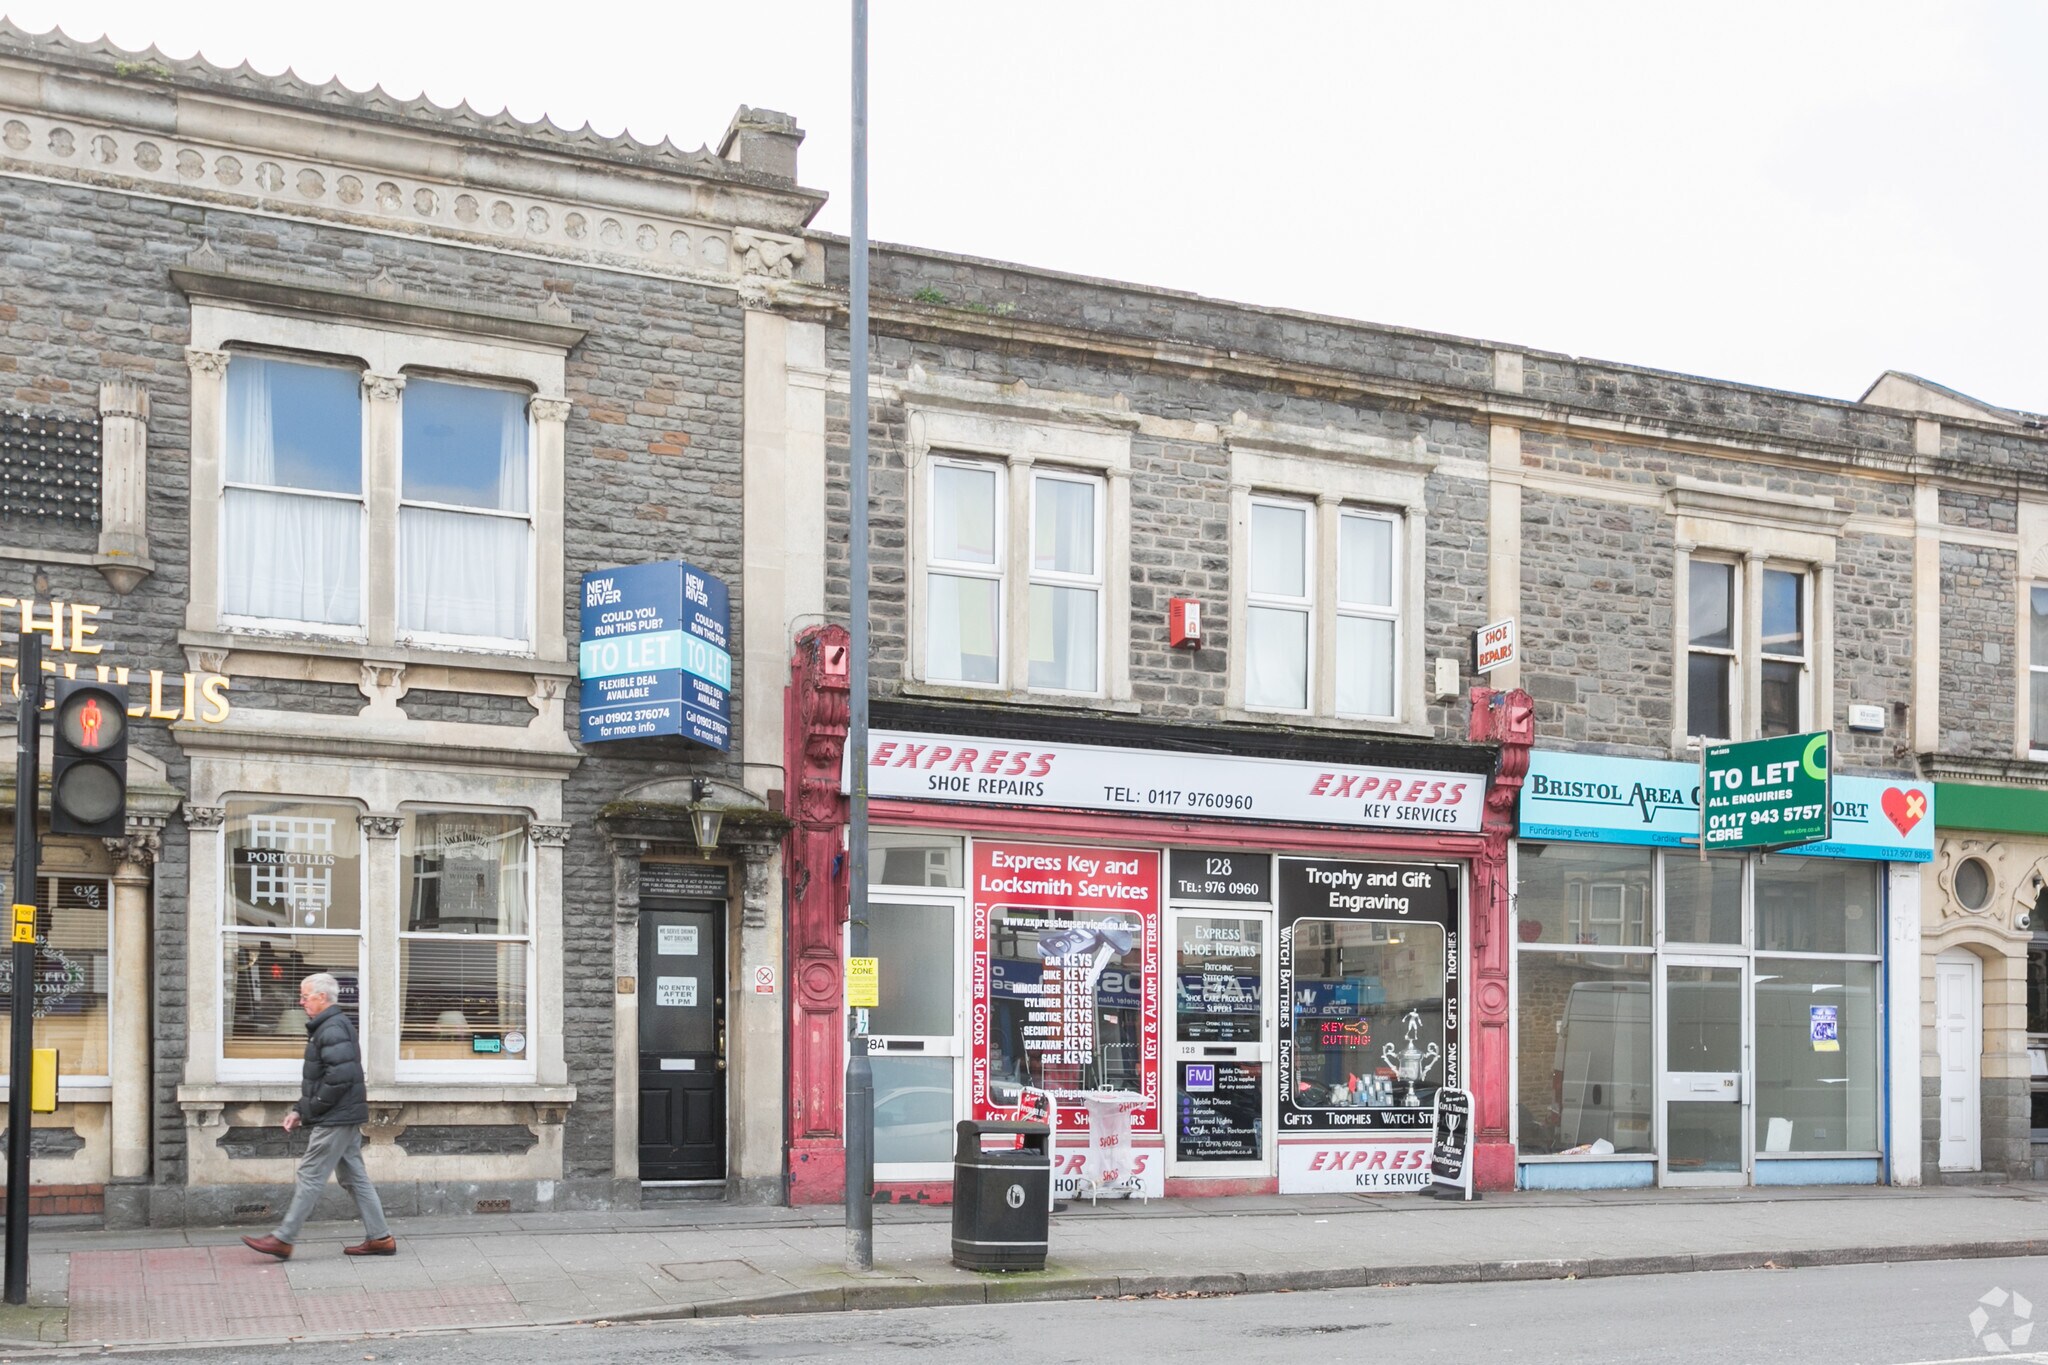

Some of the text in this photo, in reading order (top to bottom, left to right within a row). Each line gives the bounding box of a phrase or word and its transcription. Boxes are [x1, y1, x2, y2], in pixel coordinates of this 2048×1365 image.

[587, 578, 614, 594] NEW
[686, 572, 704, 592] NEW
[587, 590, 621, 607] RIVER
[686, 586, 708, 607] RIVER
[602, 608, 656, 623] COULD YOU
[695, 612, 724, 634] COULD YOU
[595, 618, 663, 636] RUN THIS PUB?
[691, 622, 703, 636] RUN
[704, 627, 715, 641] THIS
[1485, 626, 1507, 646] SHOE
[588, 636, 671, 672] TO LET
[686, 638, 728, 684] TO LET
[1480, 644, 1512, 666] REPAIRS
[599, 675, 658, 690] FLEXIBLE DEAL
[693, 679, 714, 695] FLEXIBLE
[607, 687, 649, 700] AVAILABLE
[698, 692, 720, 710] AVAILABLE
[588, 708, 670, 726] Call 01902 376074
[686, 710, 696, 722] Call
[600, 722, 656, 736] for more info
[694, 725, 702, 736] for
[702, 729, 713, 741] more
[868, 742, 1056, 777] EXPRESS
[1709, 760, 1800, 791] TO LET
[928, 775, 1044, 797] SHOE REPAIRS
[1309, 774, 1467, 805] EXPRESS
[1532, 774, 1622, 800] BRISTOL
[1628, 782, 1684, 813] AREA
[1104, 786, 1252, 810] TEL: 0117 9760960
[1709, 789, 1792, 807] ALL ENQUIRIES
[1364, 804, 1456, 822] KEY SERVICES
[1710, 812, 1746, 828] 0117
[1750, 809, 1779, 824] 943
[1783, 804, 1822, 821] 5757
[1529, 826, 1599, 838] Fundraising Events
[1652, 834, 1681, 843] Cardiac
[1706, 827, 1743, 842] CBRE
[1784, 826, 1820, 835] www.cbre.co.uk
[1806, 844, 1822, 852] Local
[1824, 846, 1846, 854] People
[1882, 849, 1930, 859] 0117 907 8895
[247, 852, 335, 866] PORTCULLIS
[992, 850, 1138, 878] Express Key and
[1206, 858, 1232, 876] 128
[1306, 868, 1431, 890] Trophy and Gift
[980, 875, 1148, 900] Locksmith Services
[1178, 880, 1259, 895] TEL: 976 0960
[1329, 892, 1410, 914] Engraving
[21, 928, 26, 936] 6
[1002, 918, 1129, 931] www.expresskeyservices.co.uk
[1196, 925, 1240, 940] EXPRESS
[1183, 941, 1256, 957] SHOE REPAIRS
[1045, 954, 1092, 966] CAR KEYS
[1204, 963, 1233, 971] PATCHING
[1043, 967, 1092, 980] BIKE KEYS
[1202, 973, 1235, 982] STITCHING
[1446, 932, 1456, 1030] GIFTS TROPHIES
[1012, 981, 1092, 994] IMMOBILISER KEYS
[974, 902, 987, 1104] LOCKS LEATHER GOODS SLIPPERS
[1024, 995, 1092, 1008] CYLINDER KEYS
[1186, 994, 1252, 1003] SHOE CARE PRODUCTS
[1029, 1009, 1092, 1022] MORTICE KEYS
[1145, 914, 1156, 1109] LOCKS KEY & ALARM BATTERIES
[1206, 1004, 1232, 1013] SLIPPERS
[1280, 926, 1292, 1102] WATCH BATTERIES ENGRAVING
[1024, 1023, 1092, 1036] SECURITY KEYS
[1324, 1022, 1343, 1032] KEY
[1024, 1037, 1092, 1050] CARAVAN KEYS
[1322, 1035, 1368, 1045] CUTTING
[1041, 1051, 1092, 1064] SAFE KEYS
[1189, 1070, 1212, 1081] FMJ
[1216, 1117, 1232, 1125] Nights
[1284, 1112, 1414, 1125] GIFTS TROPHIES WATCH
[1308, 1151, 1432, 1171] EXPRES
[1356, 1173, 1430, 1186] KEY SERVICE
